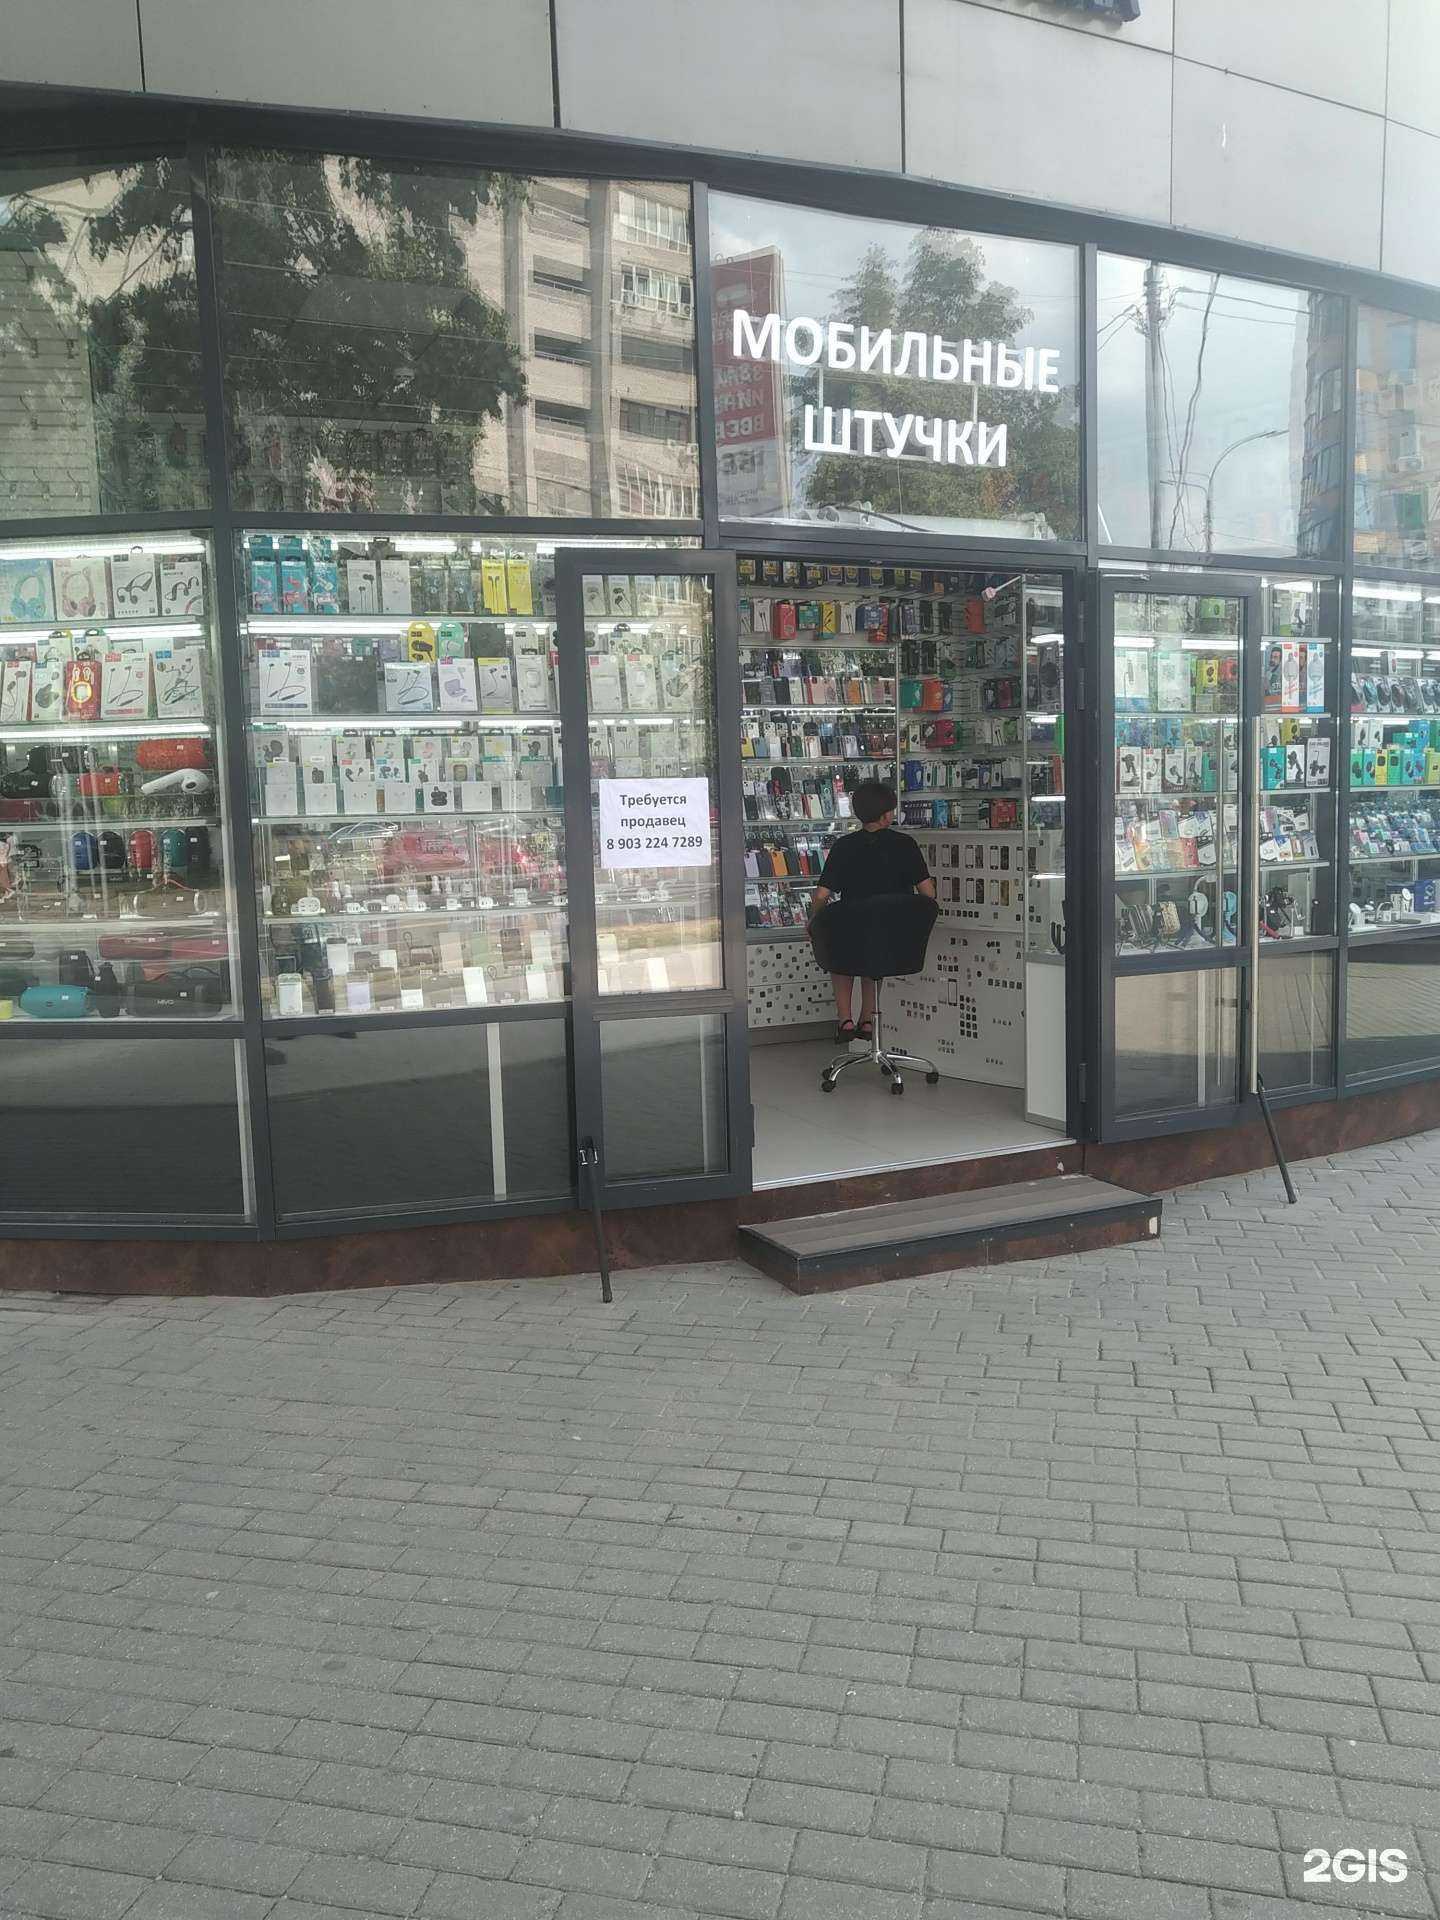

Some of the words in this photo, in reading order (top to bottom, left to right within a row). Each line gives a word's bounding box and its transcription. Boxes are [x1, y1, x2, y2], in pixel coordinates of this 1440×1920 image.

[733, 309, 1061, 393] МОБИЛЬНЫЕ
[804, 404, 1008, 467] ШТУЧКИ
[619, 793, 687, 808] Требуется
[620, 816, 686, 829] продавец
[606, 838, 615, 850] 8
[617, 837, 642, 849] 903
[645, 836, 669, 849] 224
[671, 835, 703, 848] 7289
